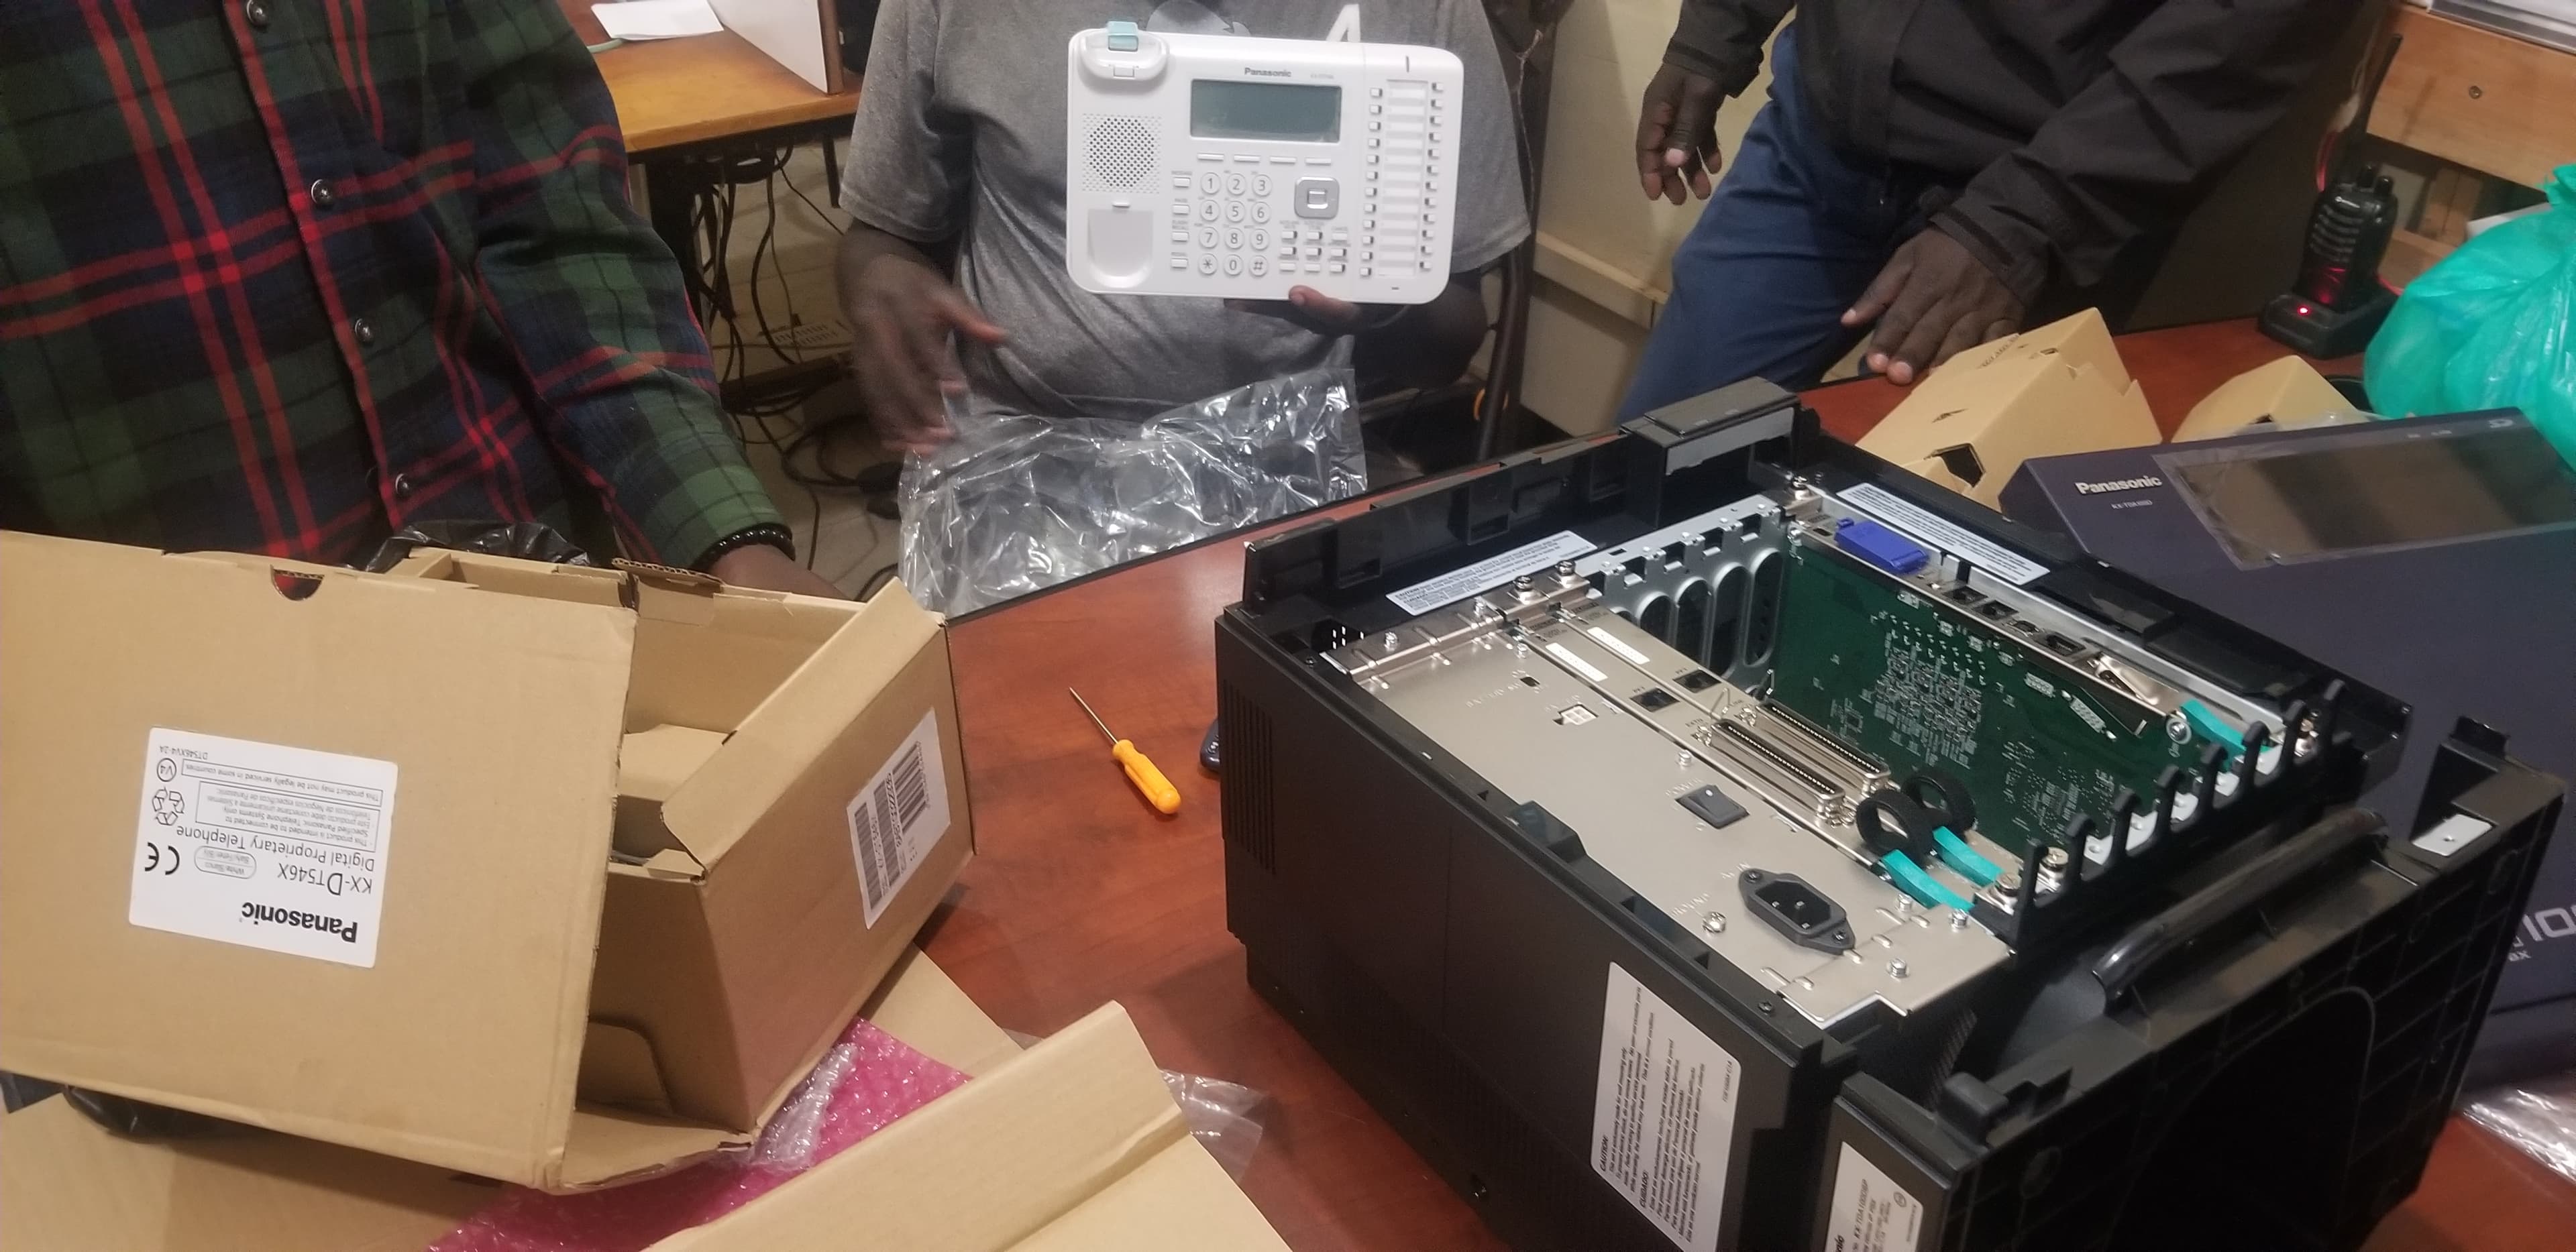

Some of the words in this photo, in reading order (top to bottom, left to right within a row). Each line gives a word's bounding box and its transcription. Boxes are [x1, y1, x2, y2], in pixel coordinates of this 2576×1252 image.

[1244, 67, 1291, 77] Panasonic
[1207, 178, 1213, 189] 1
[1232, 178, 1241, 190] 2
[1257, 180, 1266, 191] 3
[1204, 205, 1214, 215] 4
[1231, 206, 1239, 217] 5
[1256, 207, 1265, 219] 6
[1204, 232, 1214, 243] 7
[1230, 233, 1239, 244] 8
[1255, 234, 1264, 245] 9
[1228, 260, 1238, 270] 0
[2075, 475, 2163, 494] Panasonic
[160, 765, 173, 779] V4
[336, 789, 364, 798] product
[239, 810, 265, 820] Systems
[266, 814, 301, 826] Telephone
[270, 823, 278, 832] be
[288, 827, 318, 836] intended
[304, 820, 336, 832] Panasonic
[337, 826, 368, 837] Specified
[177, 826, 245, 850] Telephone
[327, 833, 354, 843] product
[251, 836, 327, 863] Proprietary
[331, 852, 374, 872] Digital
[278, 864, 372, 895] KX-DT546X
[243, 903, 358, 943] Panasonic
